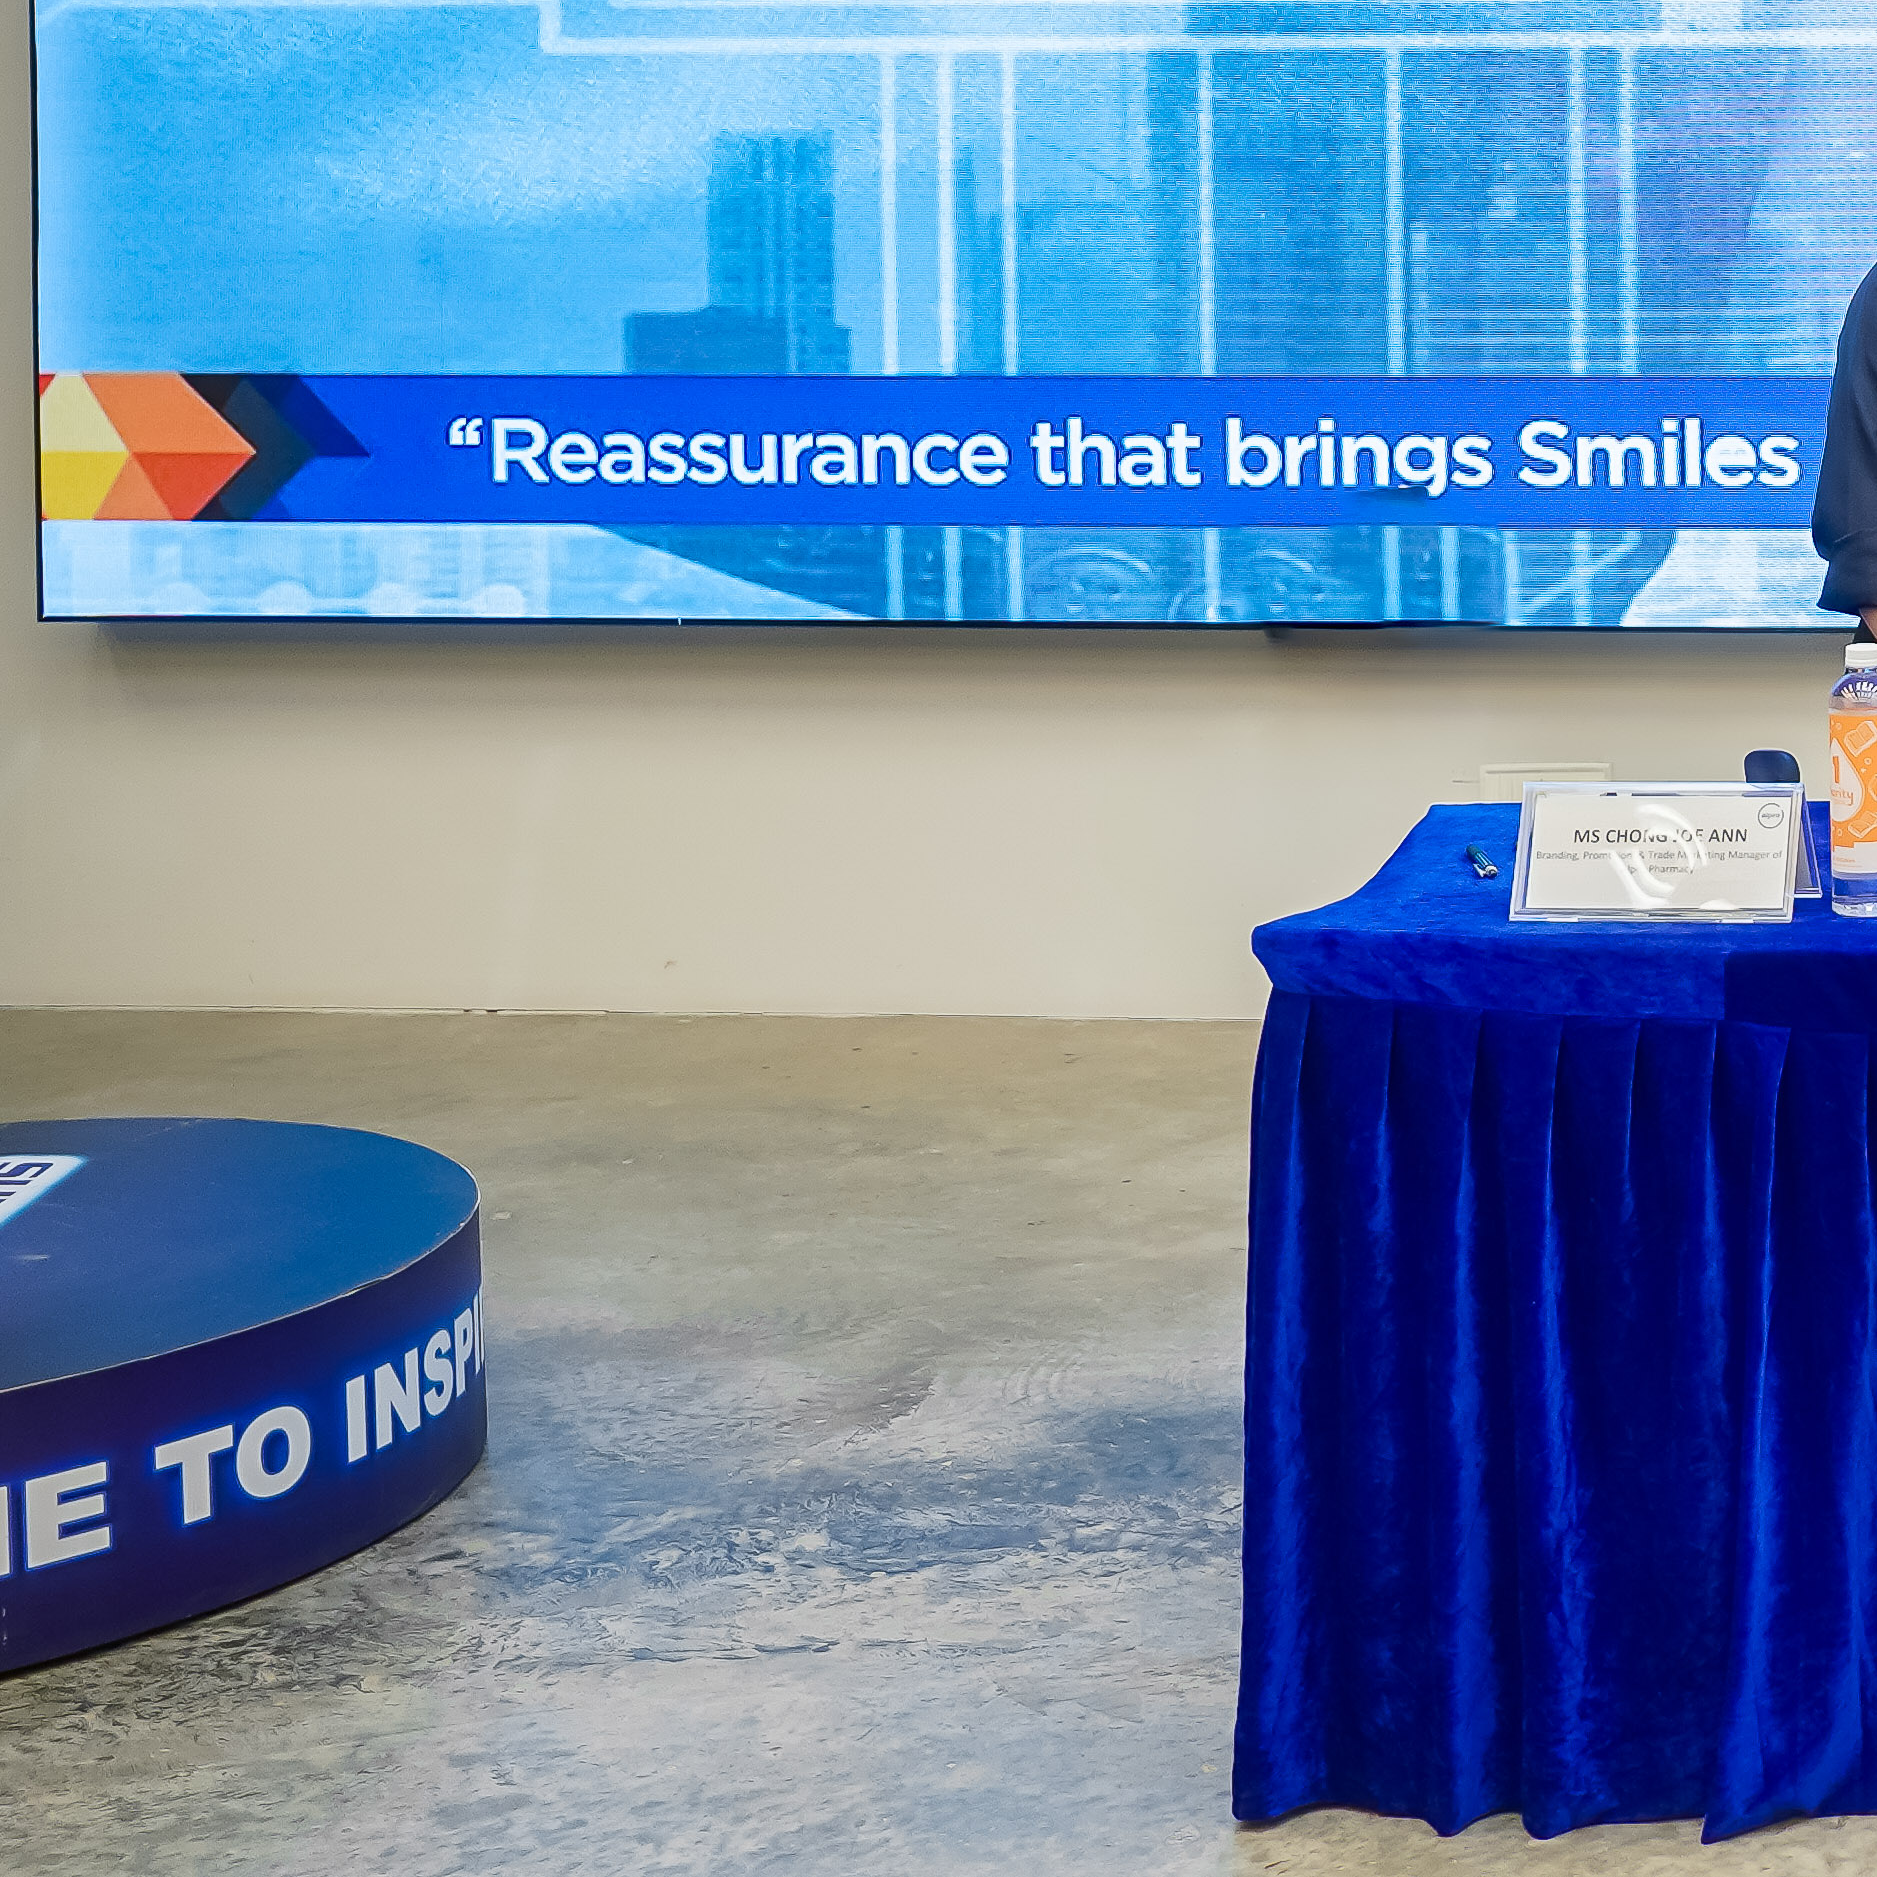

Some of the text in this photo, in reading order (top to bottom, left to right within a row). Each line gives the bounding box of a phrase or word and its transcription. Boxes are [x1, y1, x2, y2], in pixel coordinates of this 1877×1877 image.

[1032, 418, 1201, 486] that
[1227, 418, 1493, 496] brings
[1519, 419, 1799, 487] Smiles
[1536, 851, 1579, 861] Branding,
[1648, 851, 1675, 860] Trade
[1728, 851, 1771, 862] Manager
[1772, 850, 1783, 860] of
[1574, 828, 1601, 844] MS
[1708, 828, 1748, 843] ANN
[0, 1460, 113, 1578] E
[154, 1404, 312, 1526] TO
